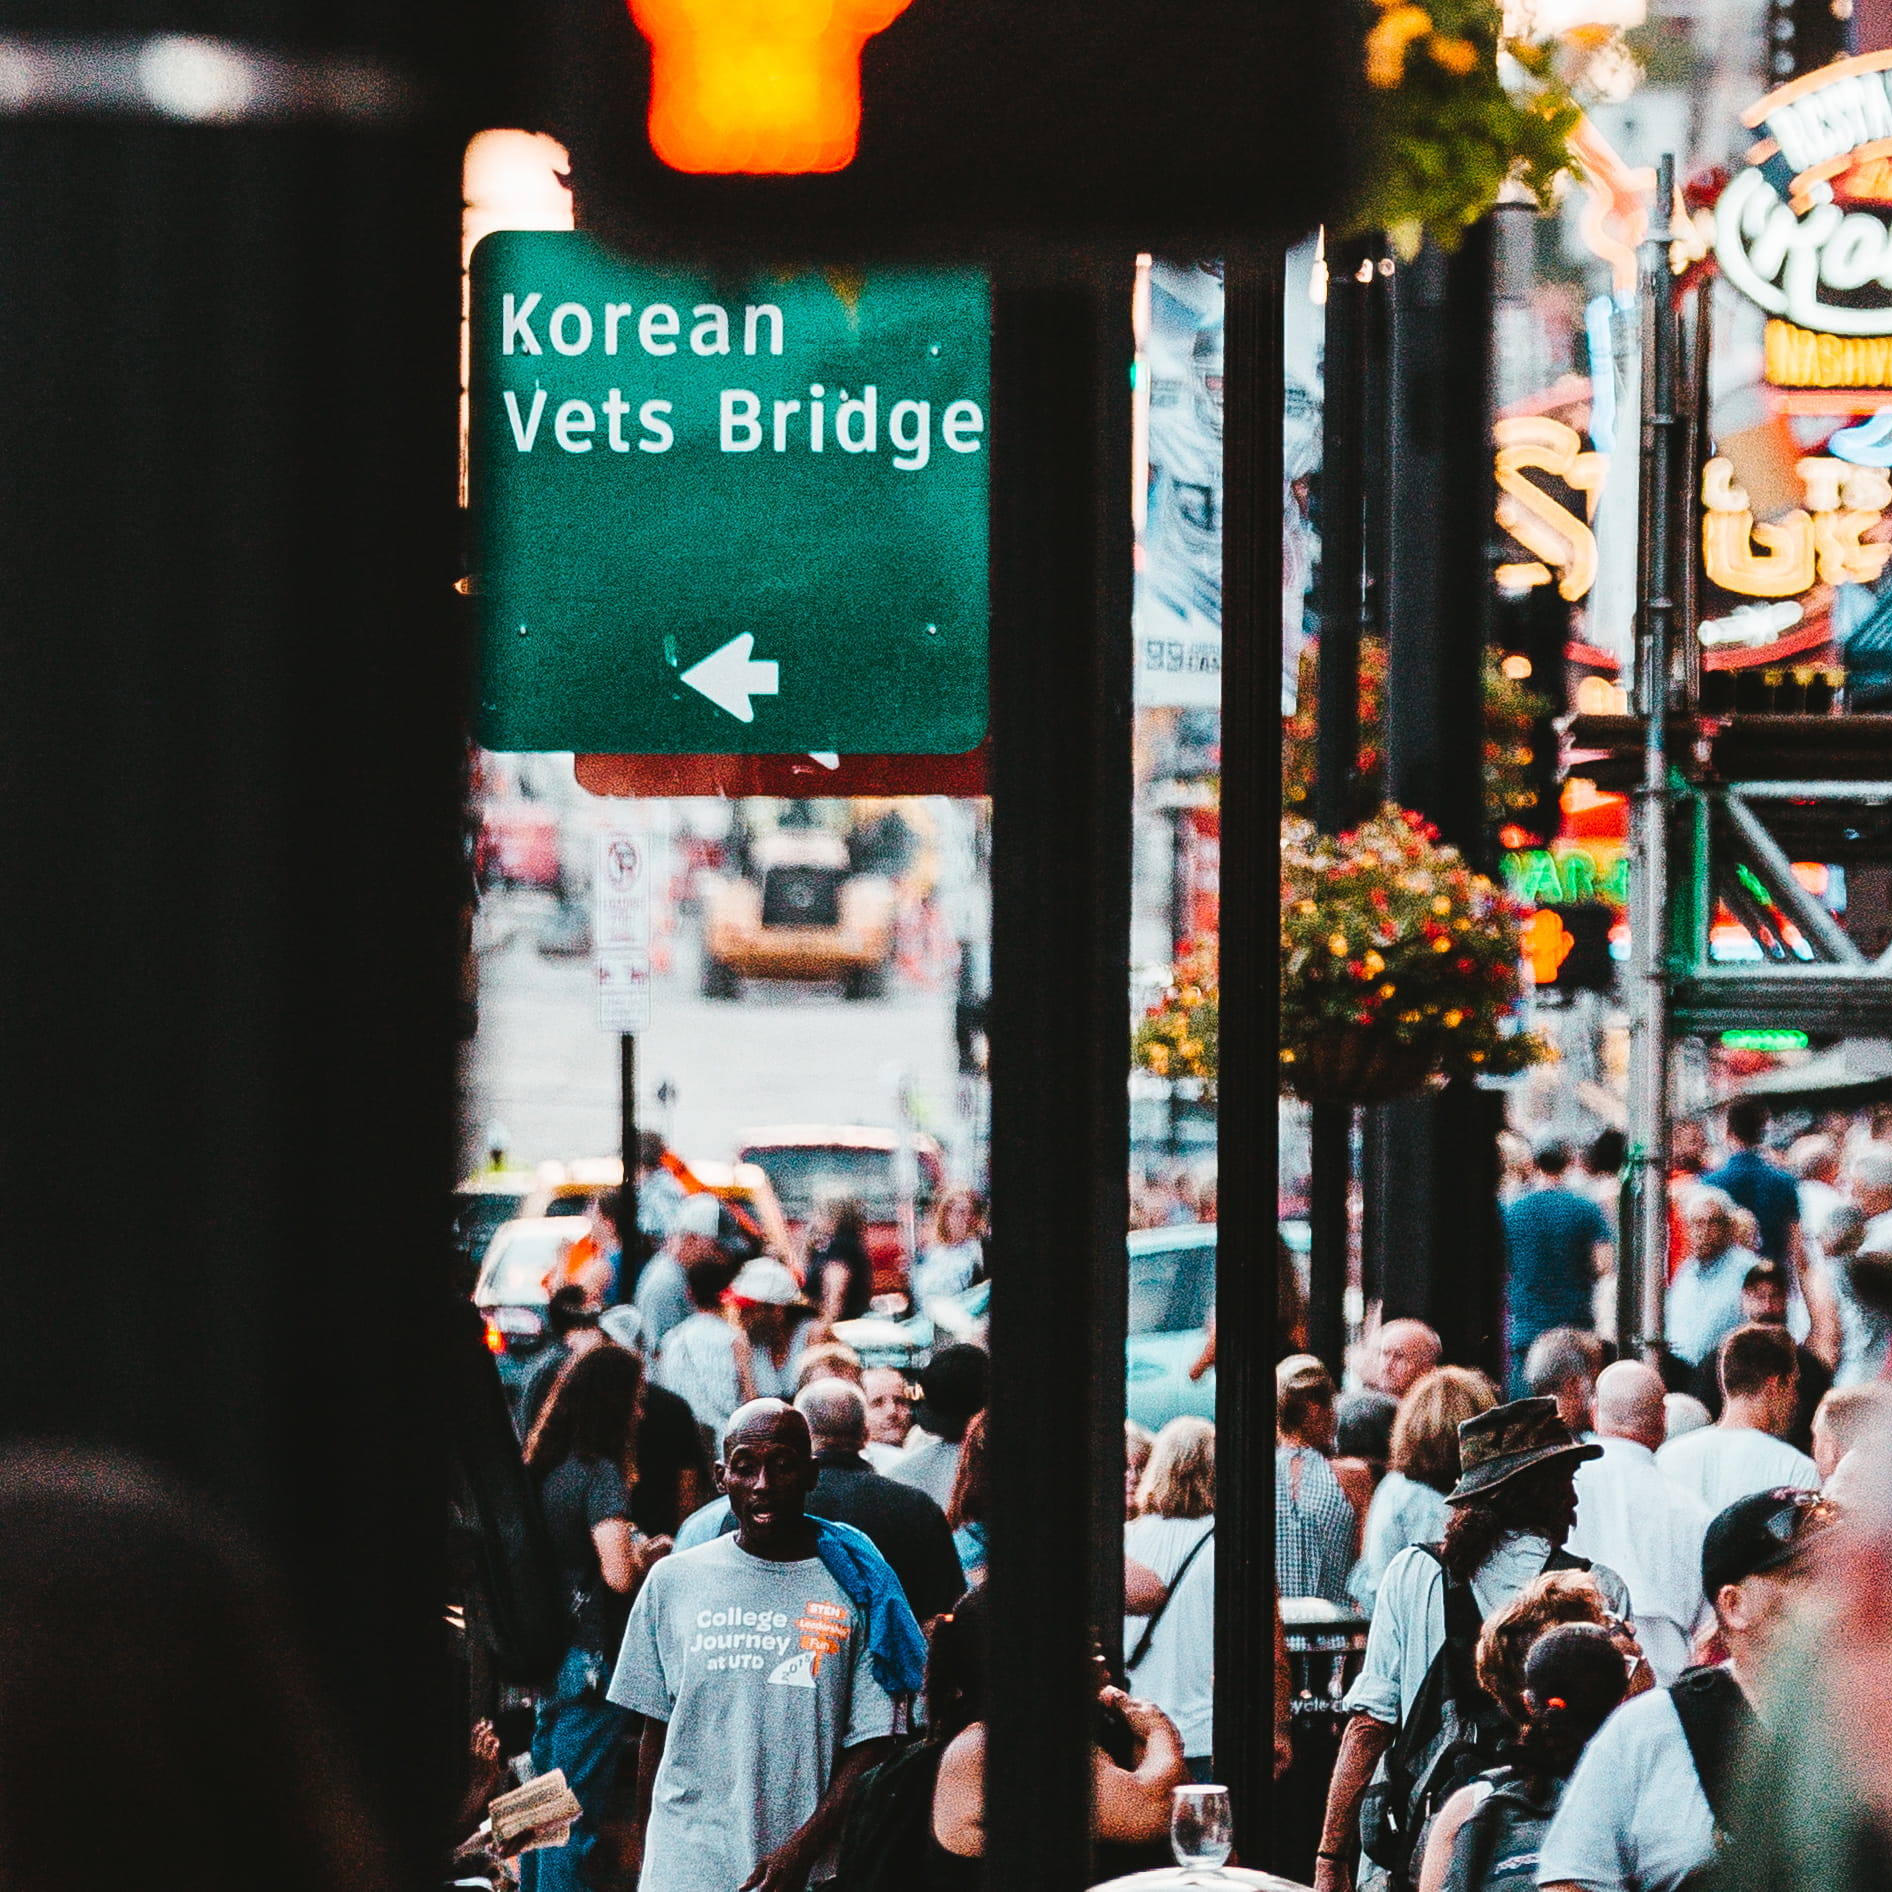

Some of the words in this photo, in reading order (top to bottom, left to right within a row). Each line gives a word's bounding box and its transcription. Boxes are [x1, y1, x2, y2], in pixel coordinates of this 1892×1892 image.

[502, 292, 785, 357] Korean
[503, 387, 675, 454] Vets
[719, 384, 986, 471] Bridge
[696, 1607, 788, 1632] College
[690, 1632, 791, 1656] Journey
[809, 1638, 830, 1651] Fun
[707, 1657, 727, 1671] at
[729, 1654, 764, 1670] UTD
